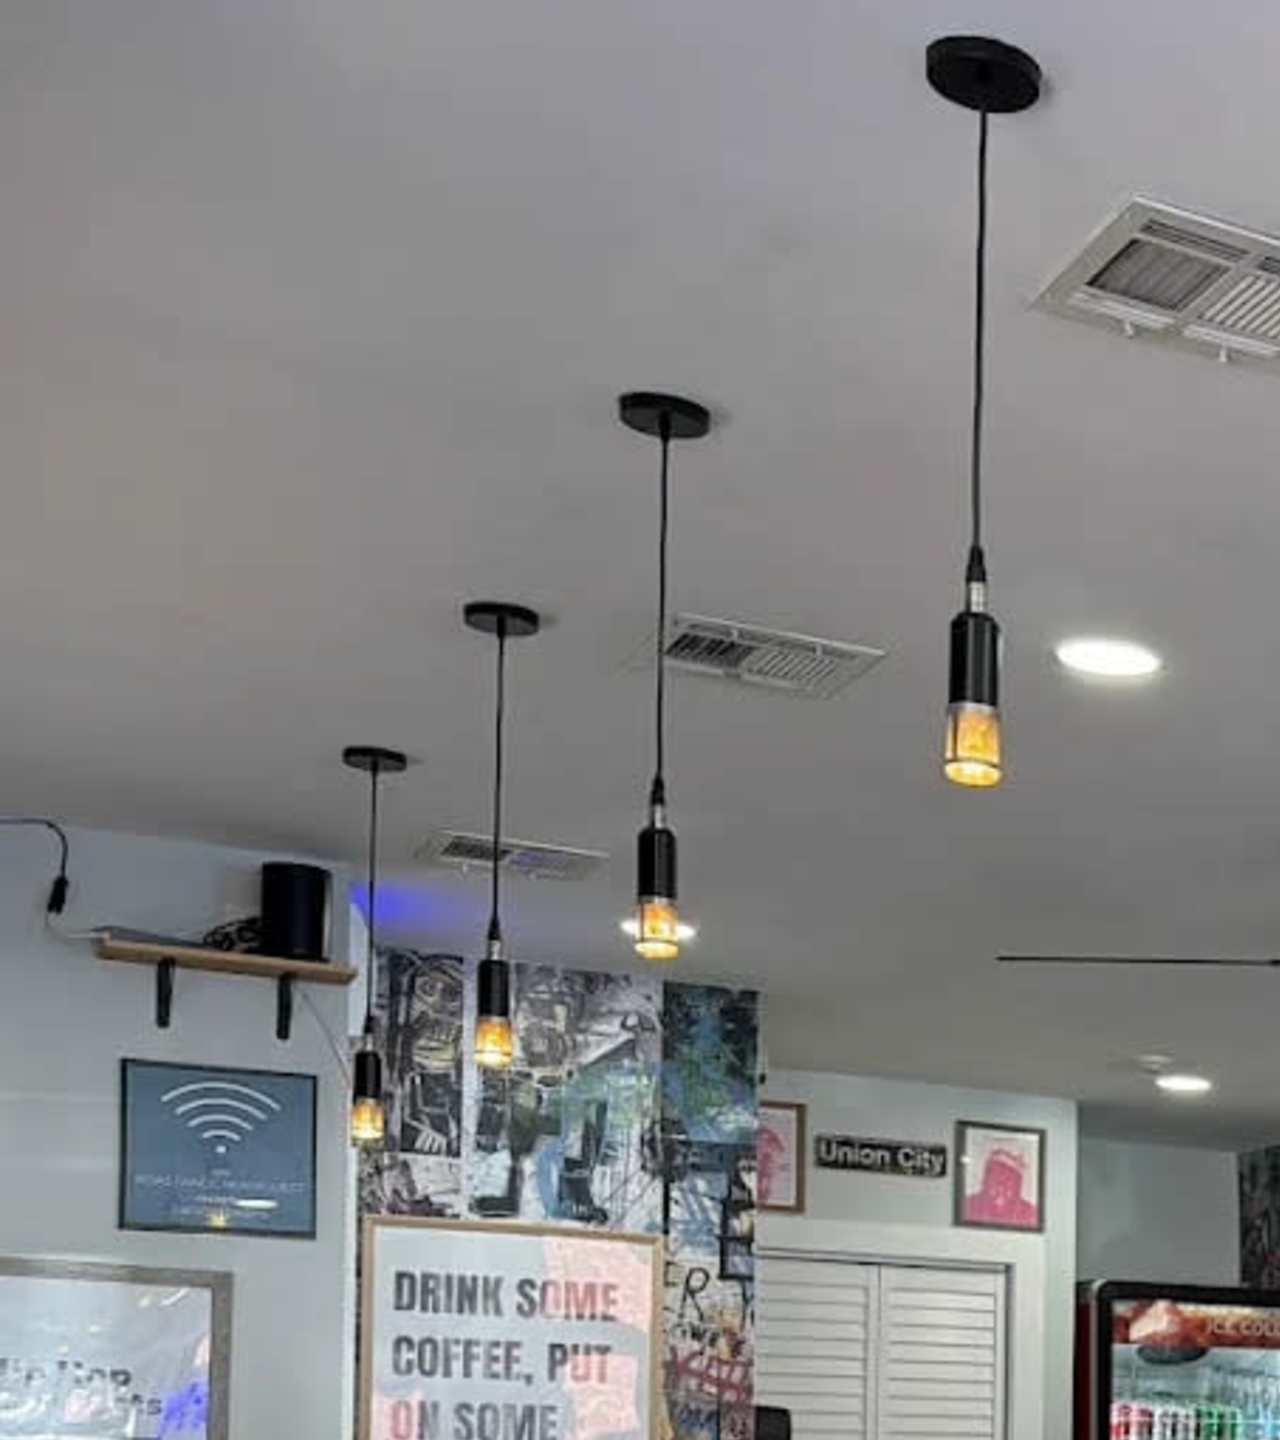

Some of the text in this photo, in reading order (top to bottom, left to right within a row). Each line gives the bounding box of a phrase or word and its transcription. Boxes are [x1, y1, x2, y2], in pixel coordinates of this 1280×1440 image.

[820, 1140, 944, 1175] Union City
[394, 1271, 619, 1322] DRINK SOME
[391, 1335, 612, 1384] COFFEE, PUT
